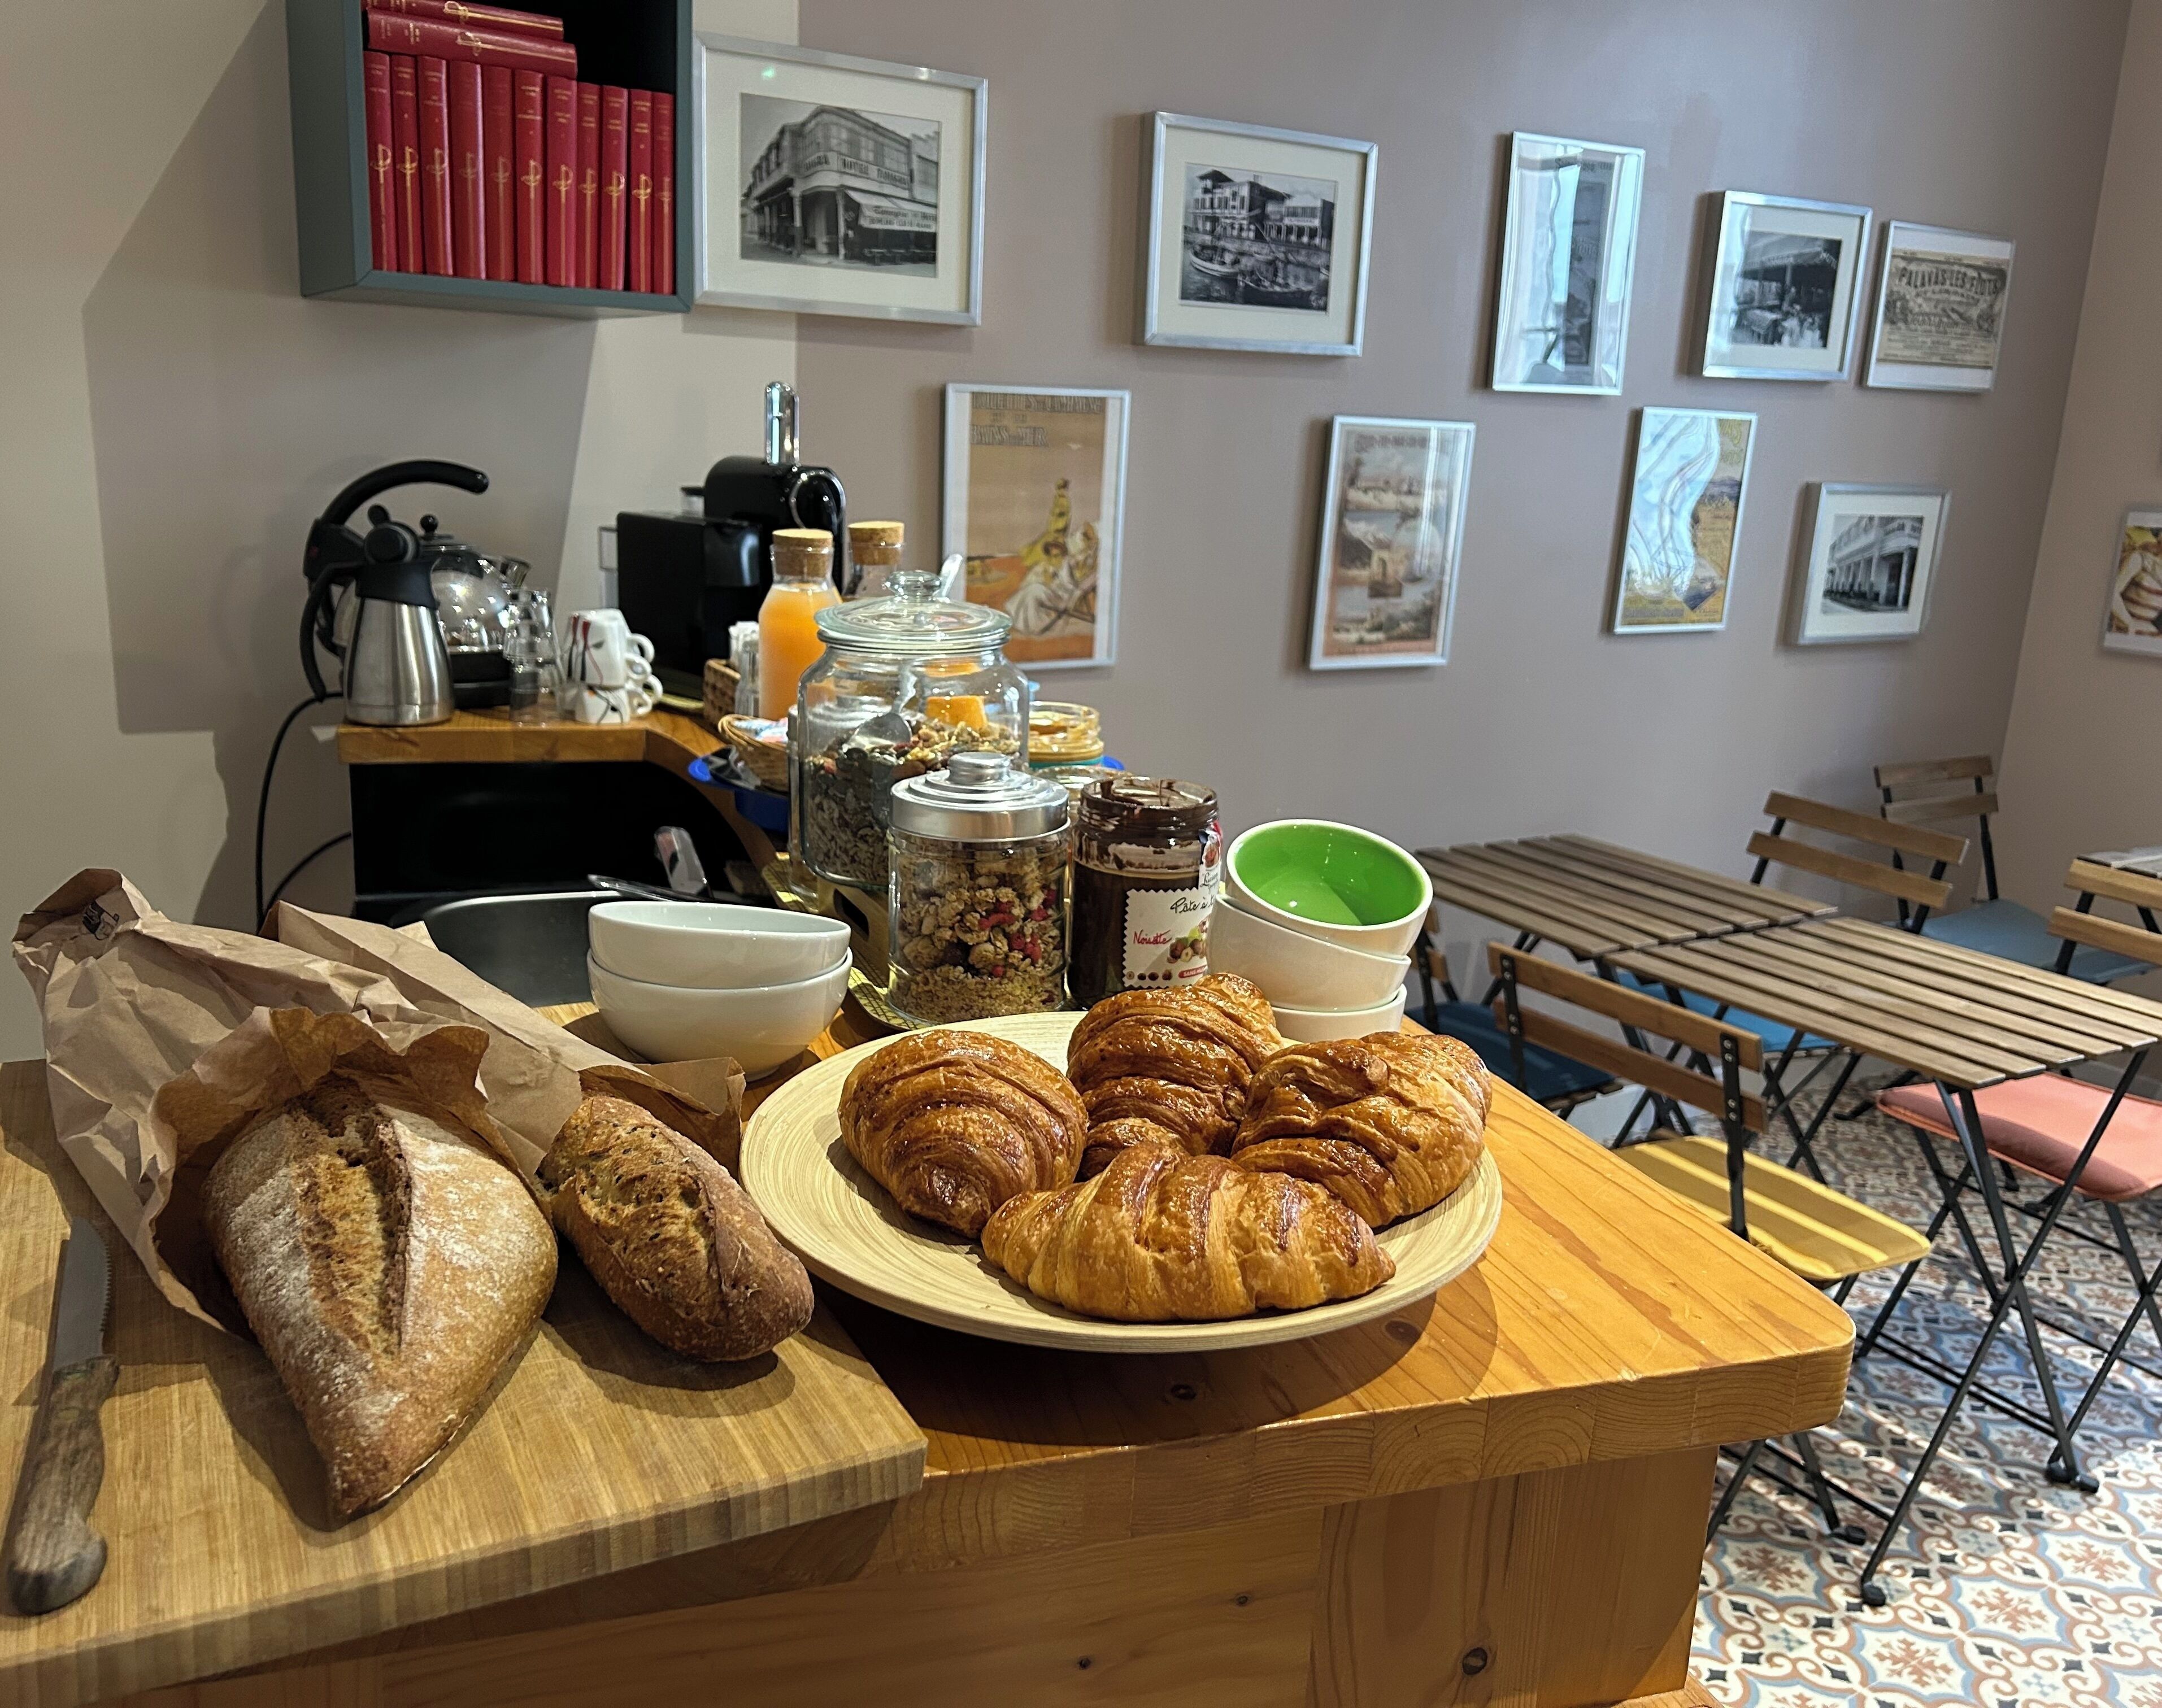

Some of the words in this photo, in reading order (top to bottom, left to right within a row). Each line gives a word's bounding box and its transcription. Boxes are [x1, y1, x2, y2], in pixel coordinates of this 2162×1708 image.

[1898, 266, 1947, 289] PALAVAS
[1949, 268, 1967, 289] LES
[1133, 929, 1172, 944] Noisette
